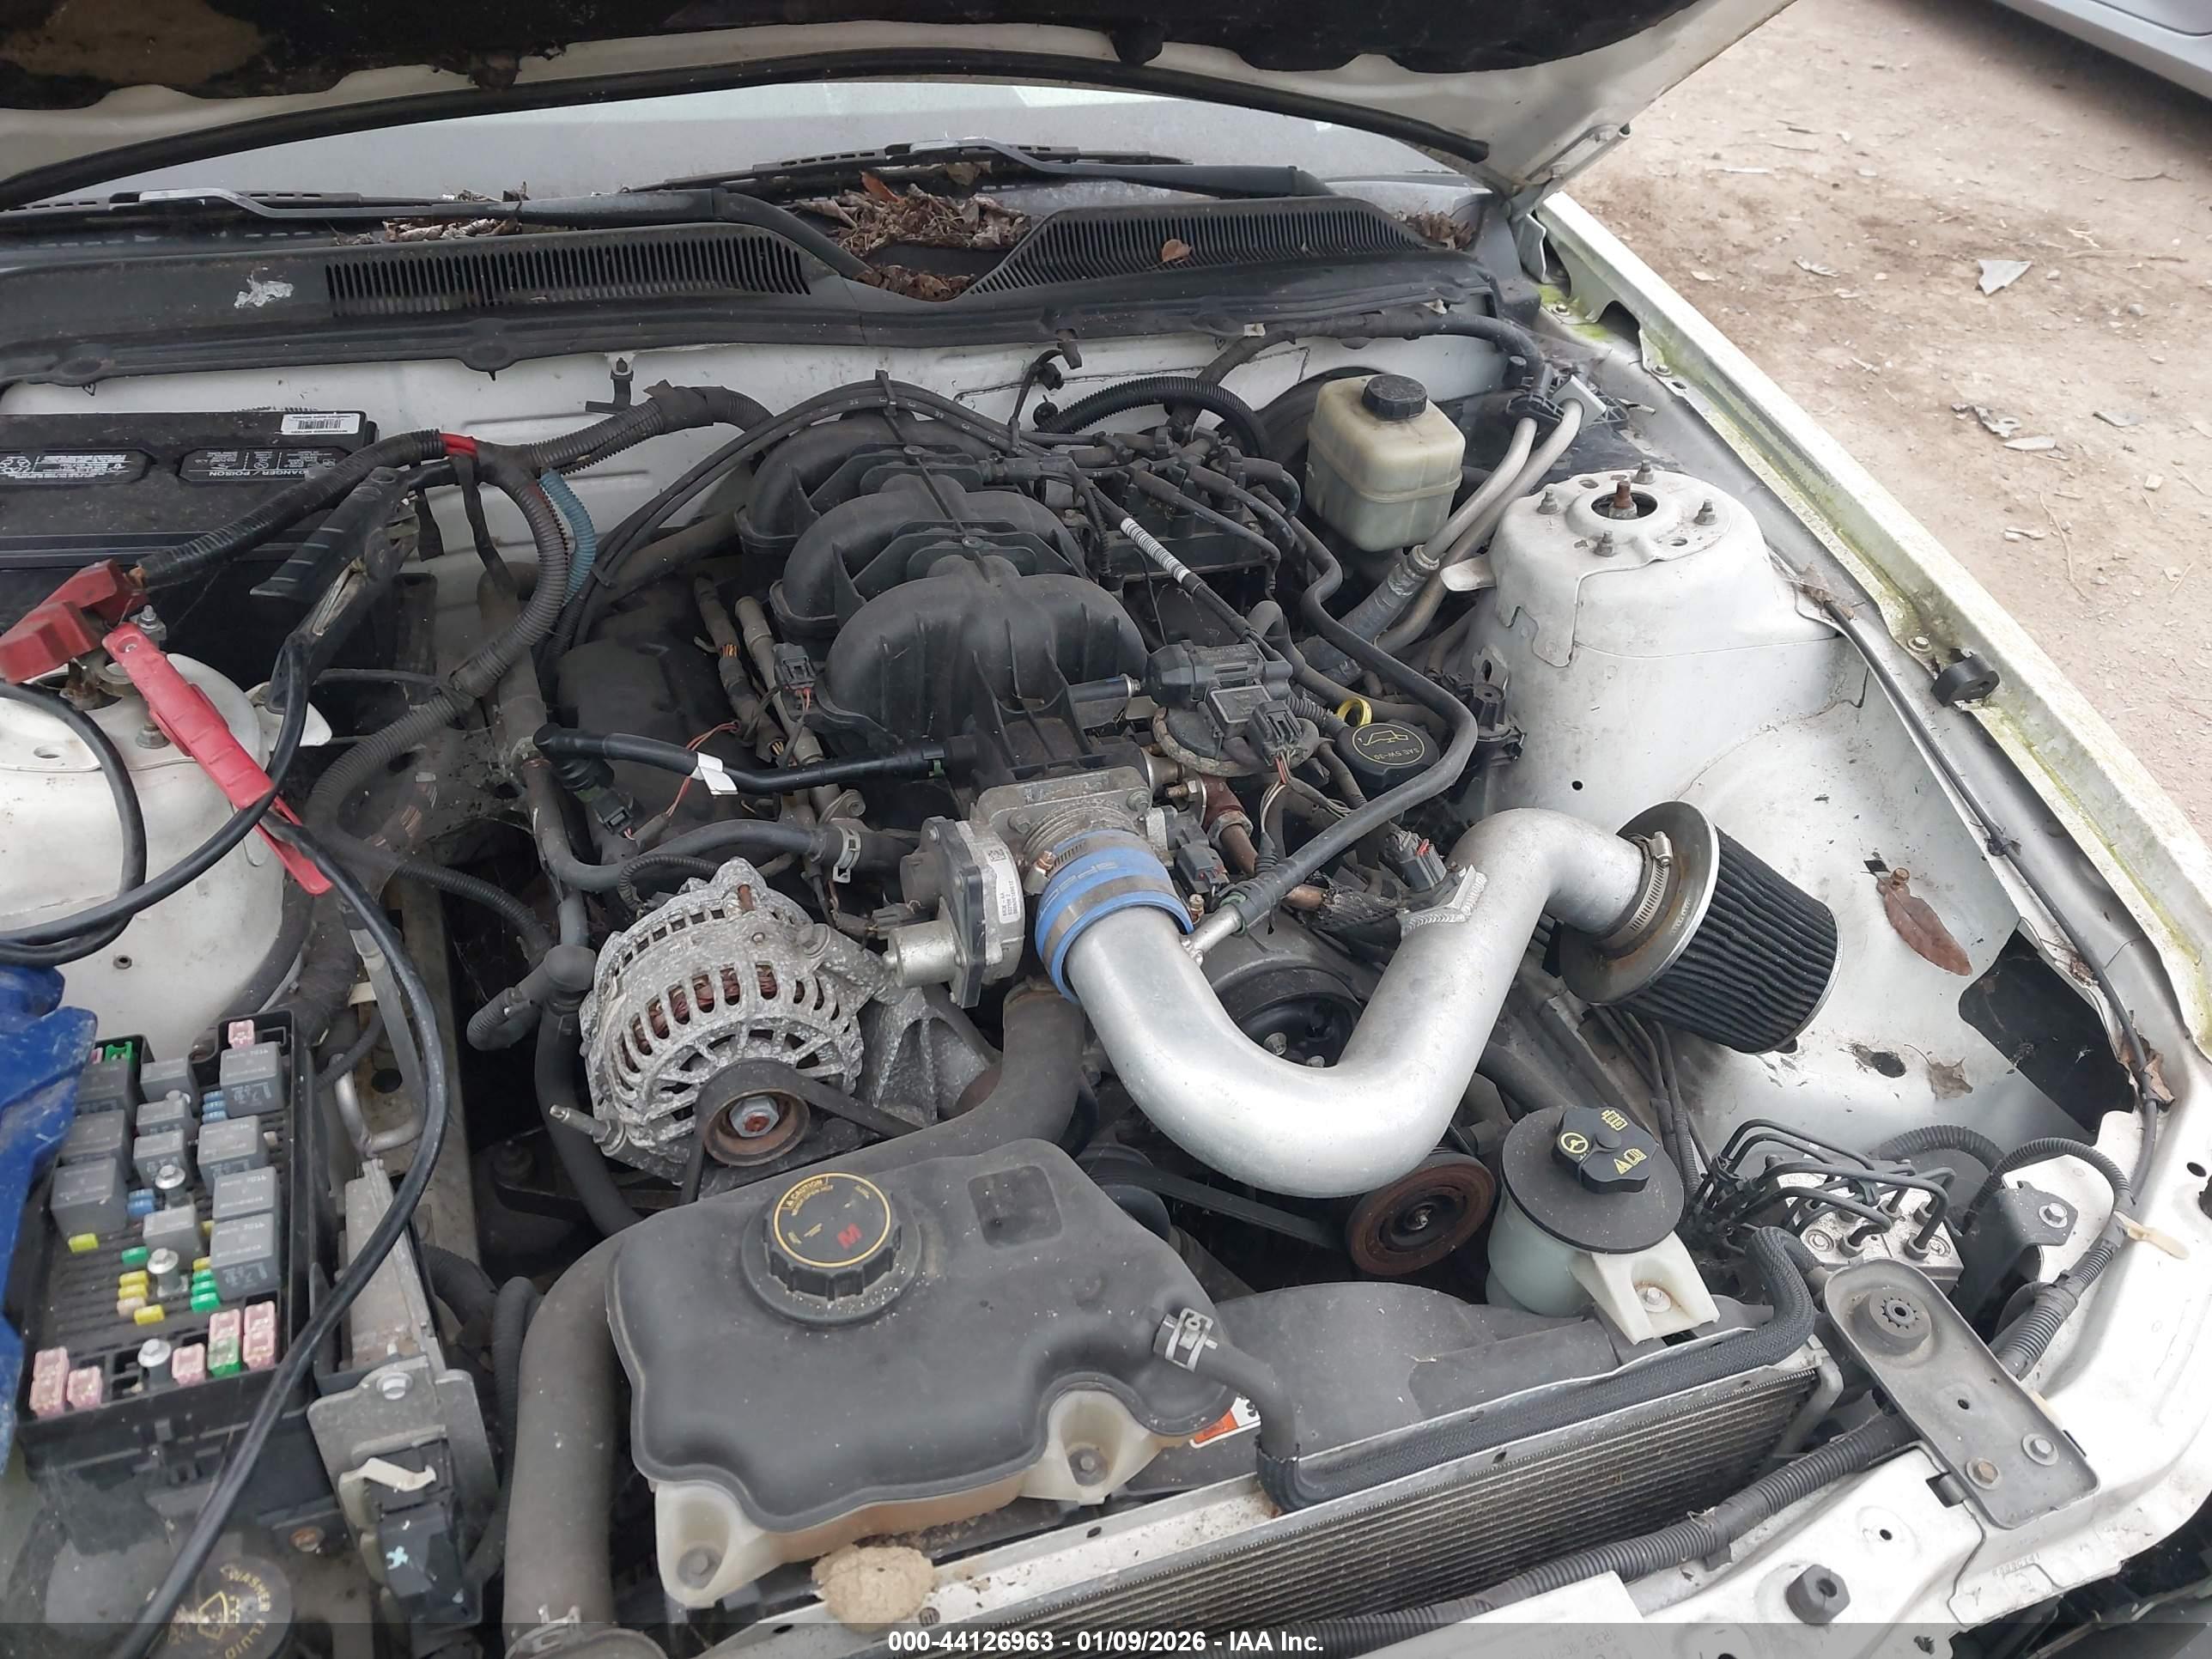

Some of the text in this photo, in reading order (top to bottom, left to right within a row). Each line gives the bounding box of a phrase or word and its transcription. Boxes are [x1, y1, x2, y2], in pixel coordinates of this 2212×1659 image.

[1373, 747, 1420, 760] SAE 5W-30
[791, 1179, 823, 1198] CAUTION
[225, 1569, 271, 1659] WASHER FLUID
